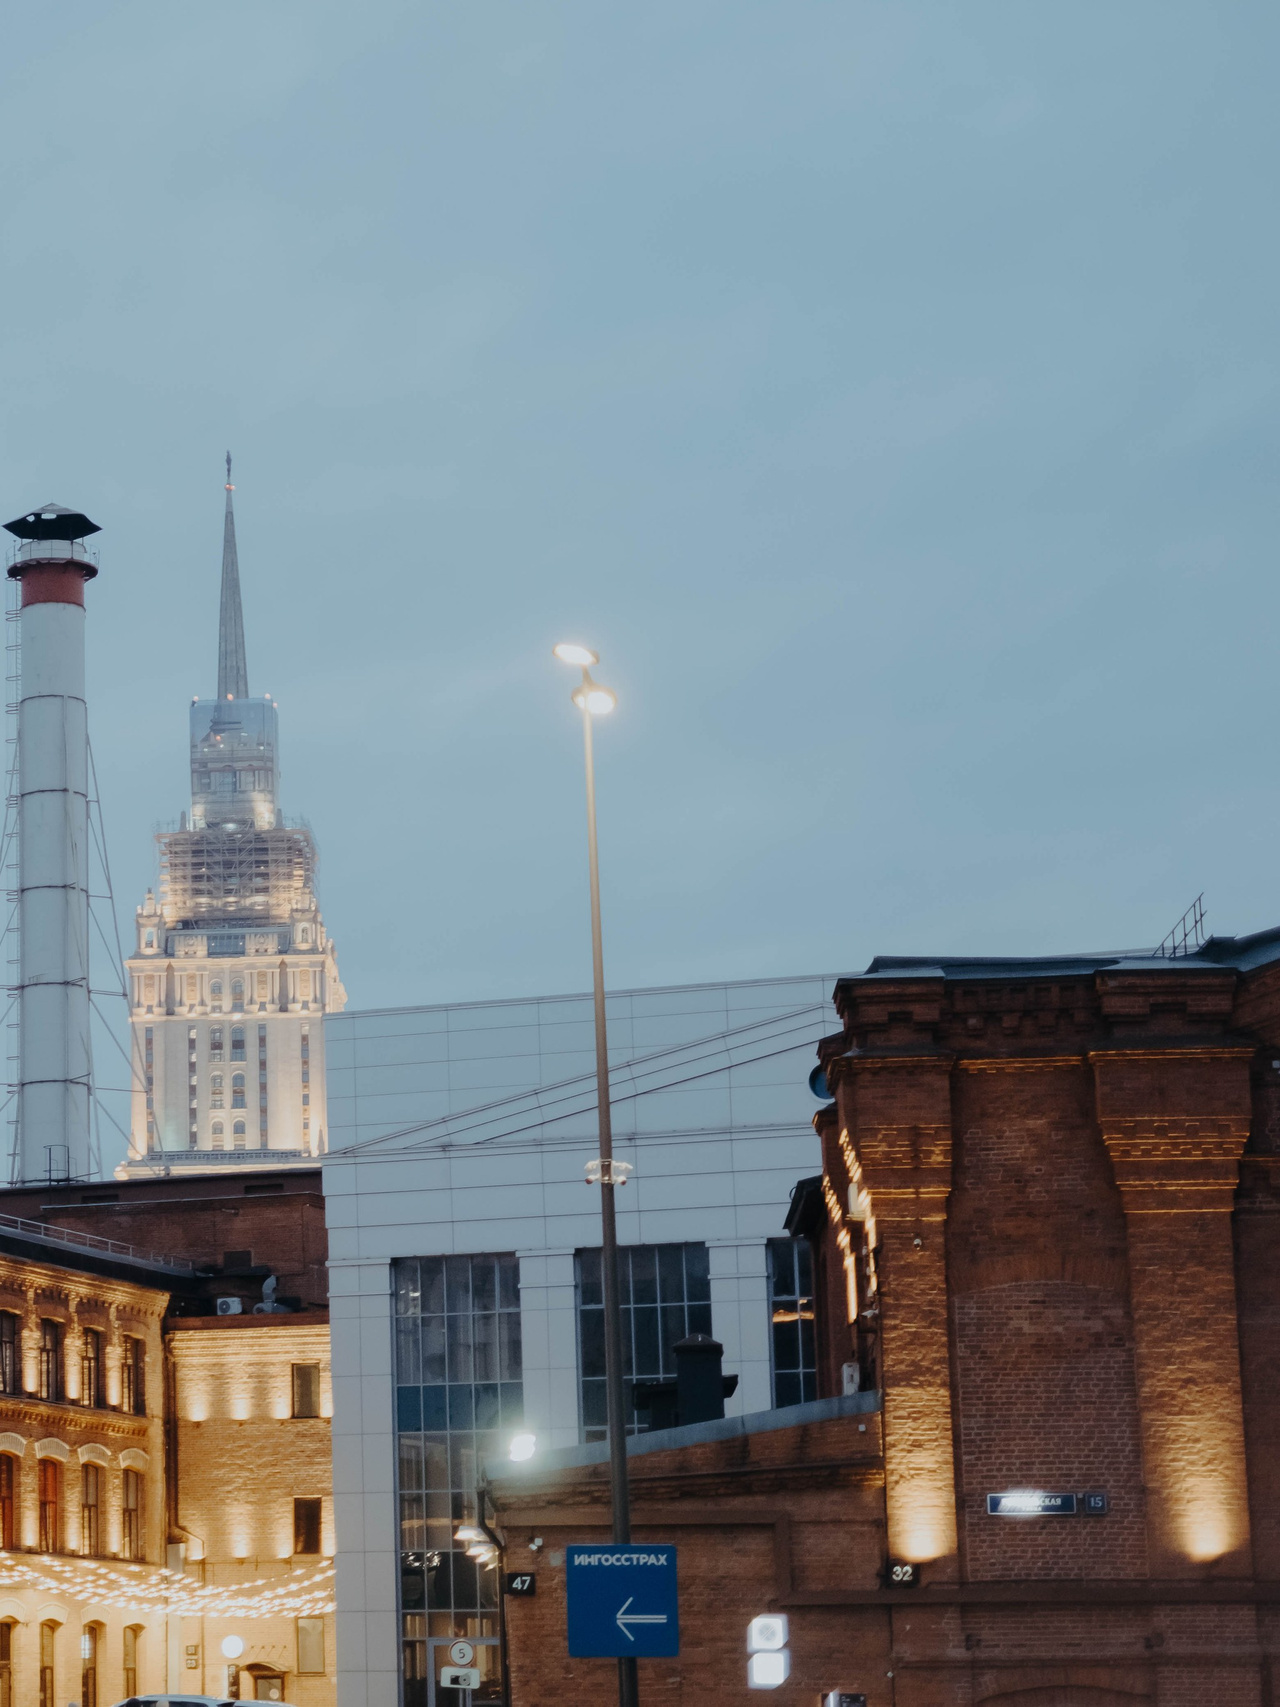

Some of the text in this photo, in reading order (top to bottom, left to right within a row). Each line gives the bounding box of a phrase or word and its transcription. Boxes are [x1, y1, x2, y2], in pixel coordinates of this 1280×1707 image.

[1090, 1497, 1102, 1508] 15
[574, 1554, 667, 1566] ИНГОССТРАХ
[892, 1565, 913, 1581] 32
[512, 1576, 531, 1590] 47
[458, 1648, 466, 1659] 5
